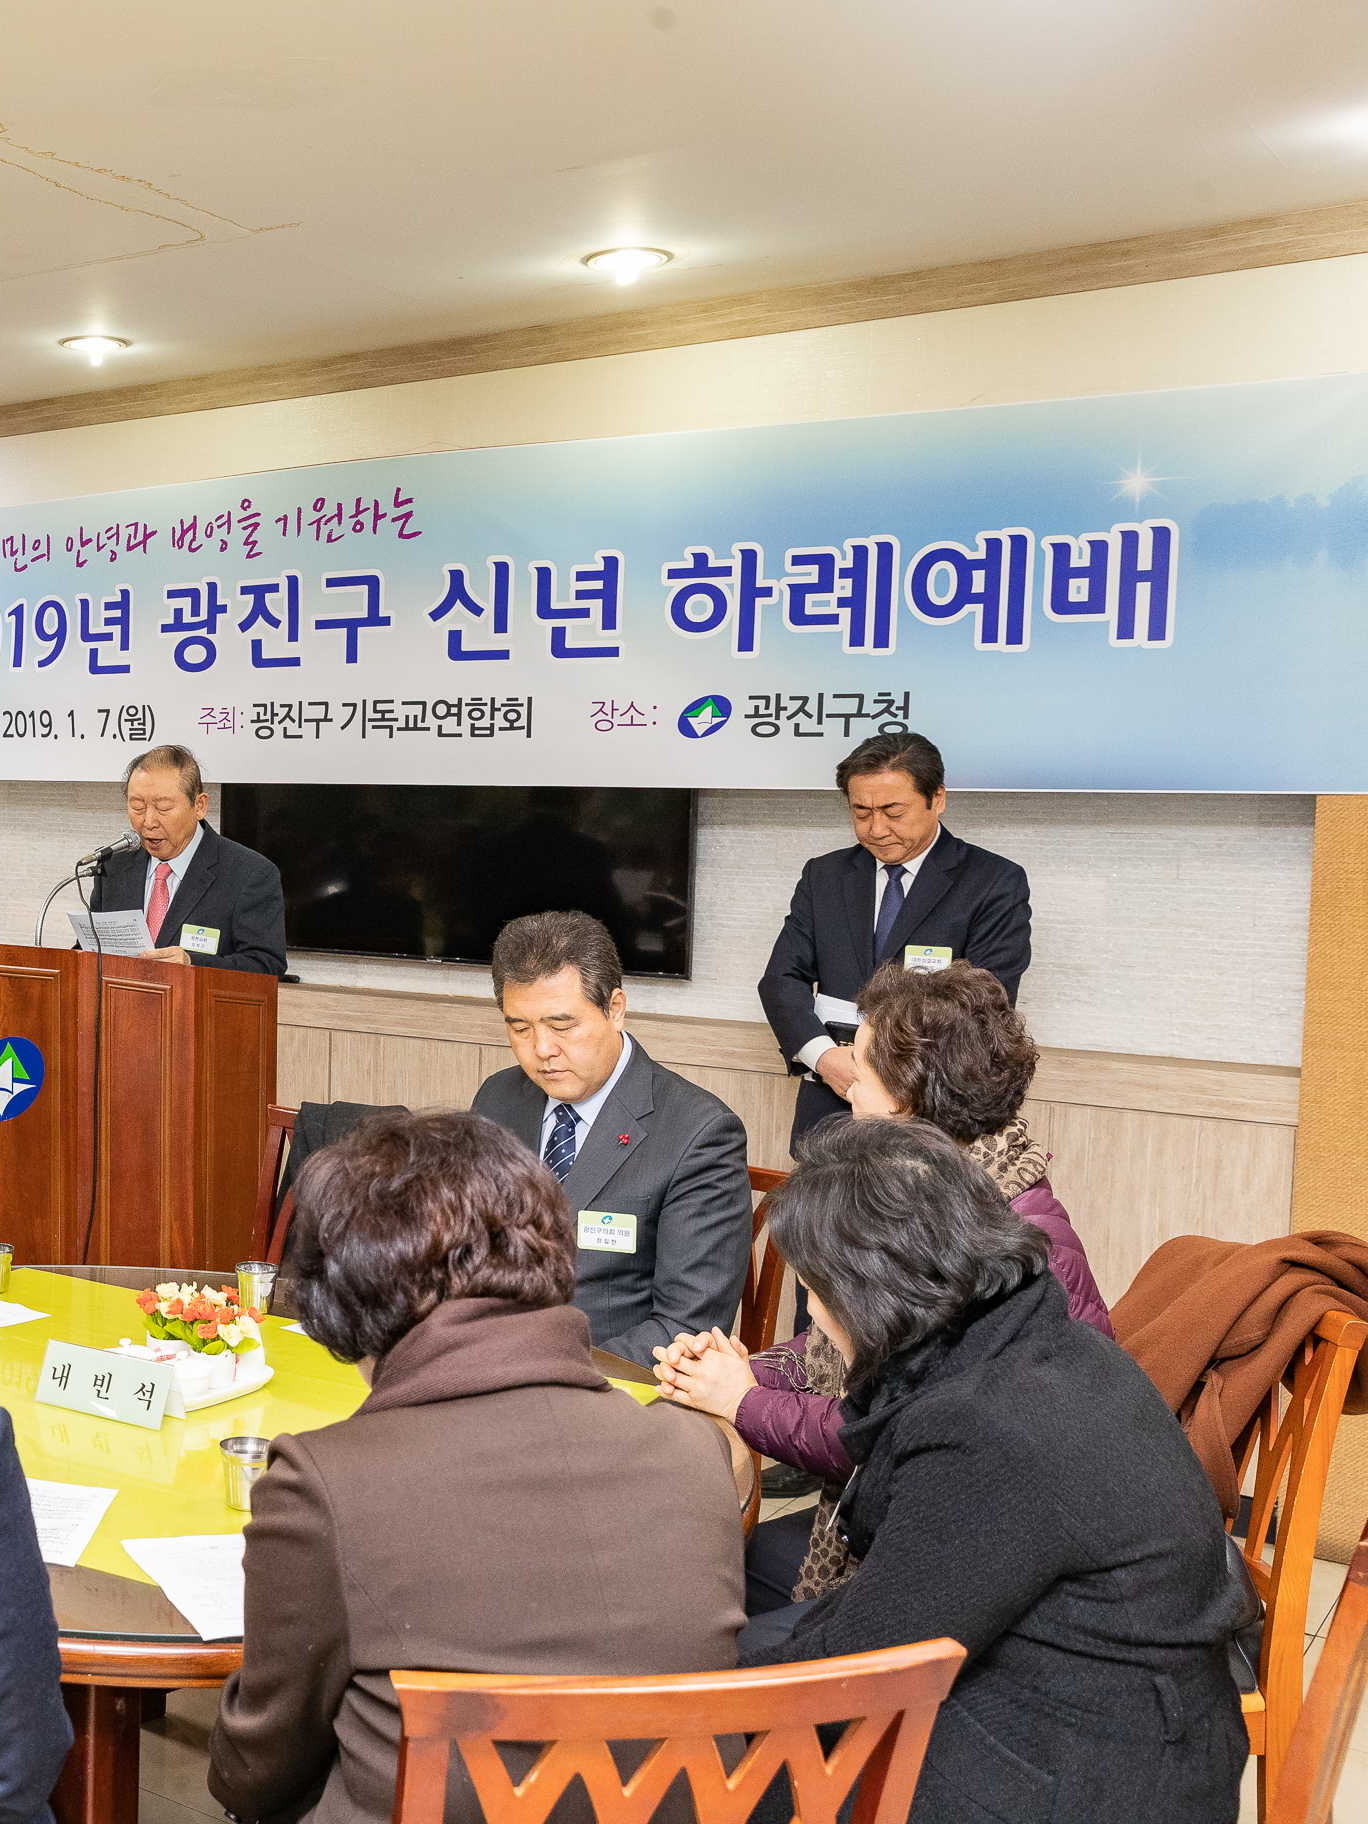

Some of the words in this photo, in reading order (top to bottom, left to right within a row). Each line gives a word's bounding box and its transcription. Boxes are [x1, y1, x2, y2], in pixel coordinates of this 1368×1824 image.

[65, 521, 158, 568] 안녕과
[172, 498, 263, 560] 번영을
[275, 487, 423, 543] 기원하는
[160, 570, 392, 673] 광진구
[428, 555, 620, 662] 신년
[666, 525, 1172, 653] 하례예배
[2, 709, 59, 739] 2019.
[67, 709, 85, 739] 1.
[197, 705, 245, 735] 주최:
[249, 700, 334, 741] 광진구
[339, 695, 533, 741] 기독교연합회
[589, 698, 659, 734] 장소:
[743, 691, 911, 738] 광진구청
[584, 1227, 616, 1236] 광진구의회
[51, 1362, 72, 1391] 내
[92, 1371, 113, 1401] 빈
[133, 1381, 156, 1411] 석
